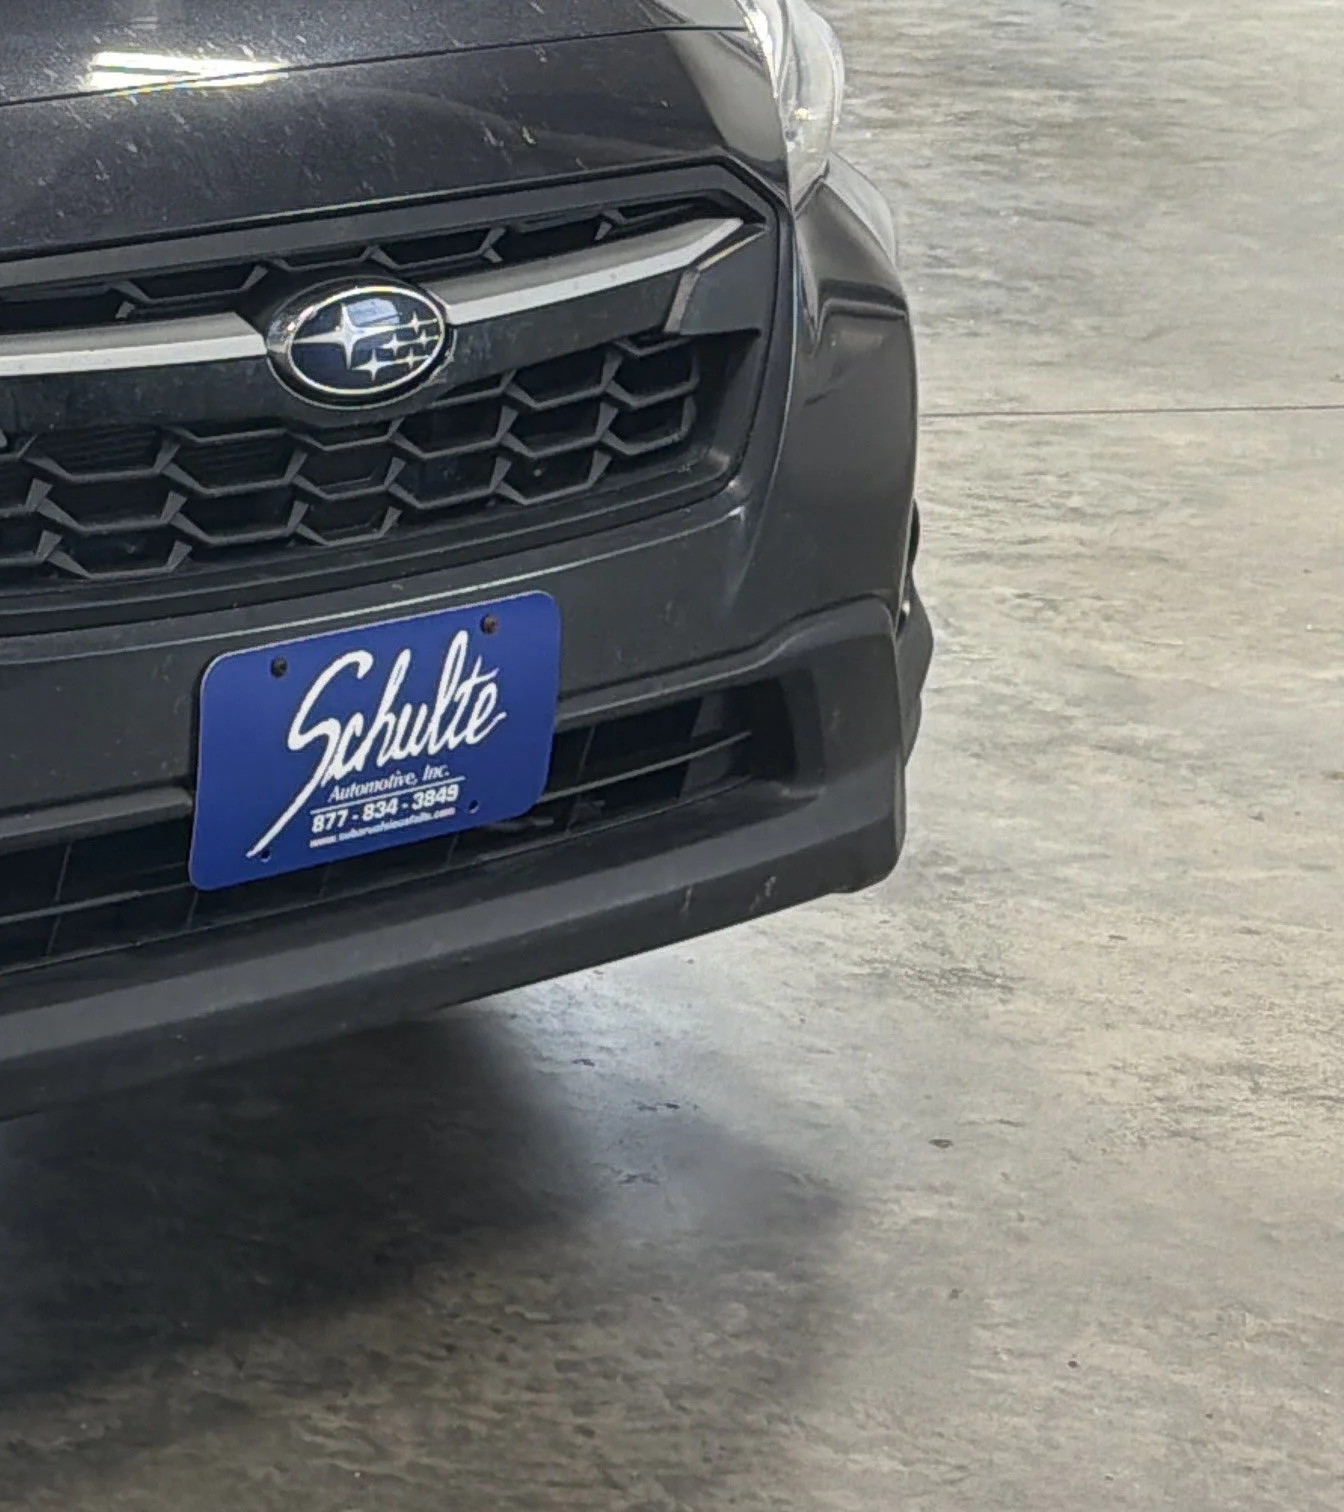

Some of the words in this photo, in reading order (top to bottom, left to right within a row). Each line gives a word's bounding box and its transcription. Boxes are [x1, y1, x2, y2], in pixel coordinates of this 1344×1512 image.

[244, 629, 508, 858] Schulte
[327, 769, 418, 803] Automotive,
[421, 764, 450, 782] Inc.
